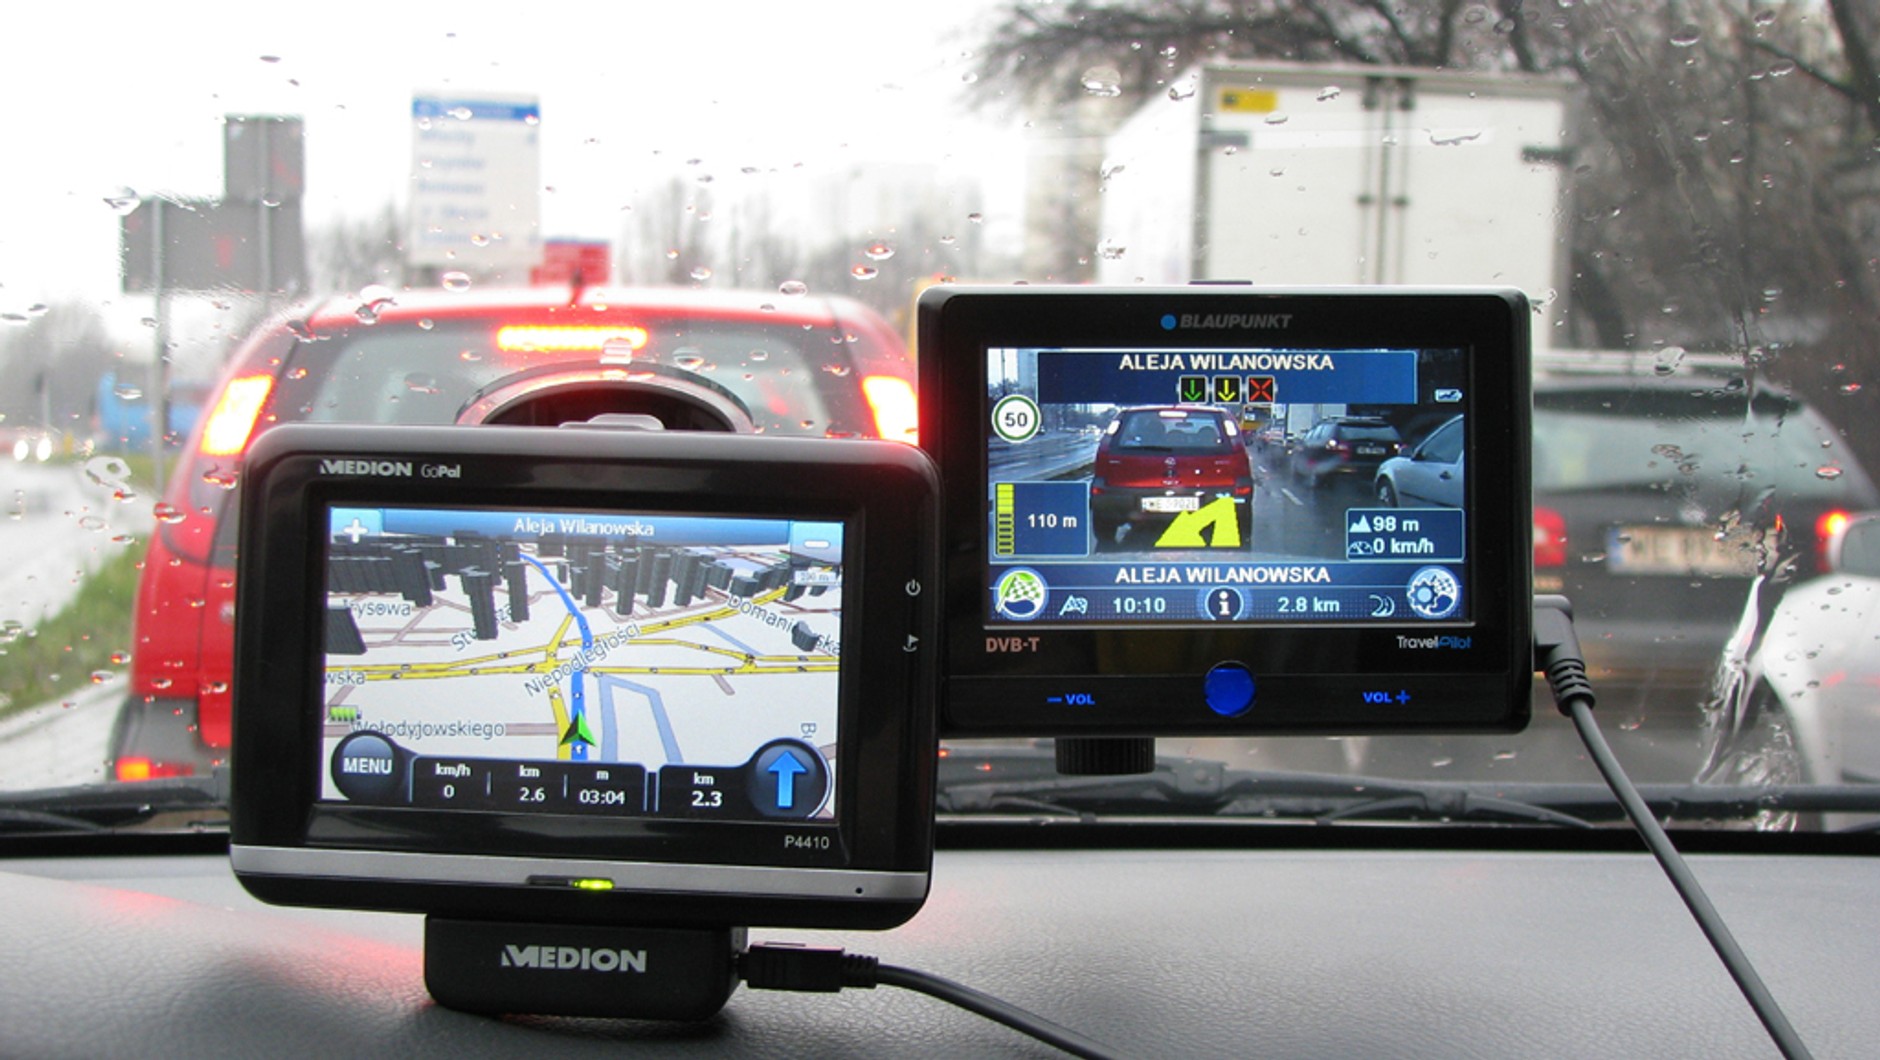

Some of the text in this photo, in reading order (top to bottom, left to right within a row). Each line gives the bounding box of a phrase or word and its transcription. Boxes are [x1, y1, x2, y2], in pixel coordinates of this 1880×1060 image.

[1179, 313, 1293, 330] BLAUPUNKT
[1119, 353, 1335, 371] ALEJA WILANOWSKA
[1004, 412, 1029, 428] 50
[319, 459, 413, 477] MEDION
[420, 464, 461, 479] GoPal
[514, 516, 655, 537] Aleja Wilanowska
[1027, 513, 1078, 529] 110 m
[1372, 515, 1420, 533] 98 m
[1372, 537, 1435, 556] 0 km/h
[1114, 565, 1332, 584] ALEJA WILANOWSKA
[1112, 597, 1166, 614] 10:10
[1277, 596, 1341, 613] 2.8 km
[985, 636, 1041, 653] DVB-T
[523, 621, 644, 698] Niepodległości
[1065, 693, 1096, 705] VOL
[1362, 691, 1393, 704] VOL
[342, 757, 393, 775] MENU
[435, 762, 472, 778] km/h
[519, 764, 541, 778] km
[596, 770, 610, 781] m
[693, 771, 715, 786] km
[442, 784, 456, 799] 0
[519, 786, 546, 802] 2.6
[578, 789, 627, 806] 03:04
[690, 790, 723, 807] 2.3
[784, 834, 830, 850] P4410
[500, 944, 648, 974] MEDION
